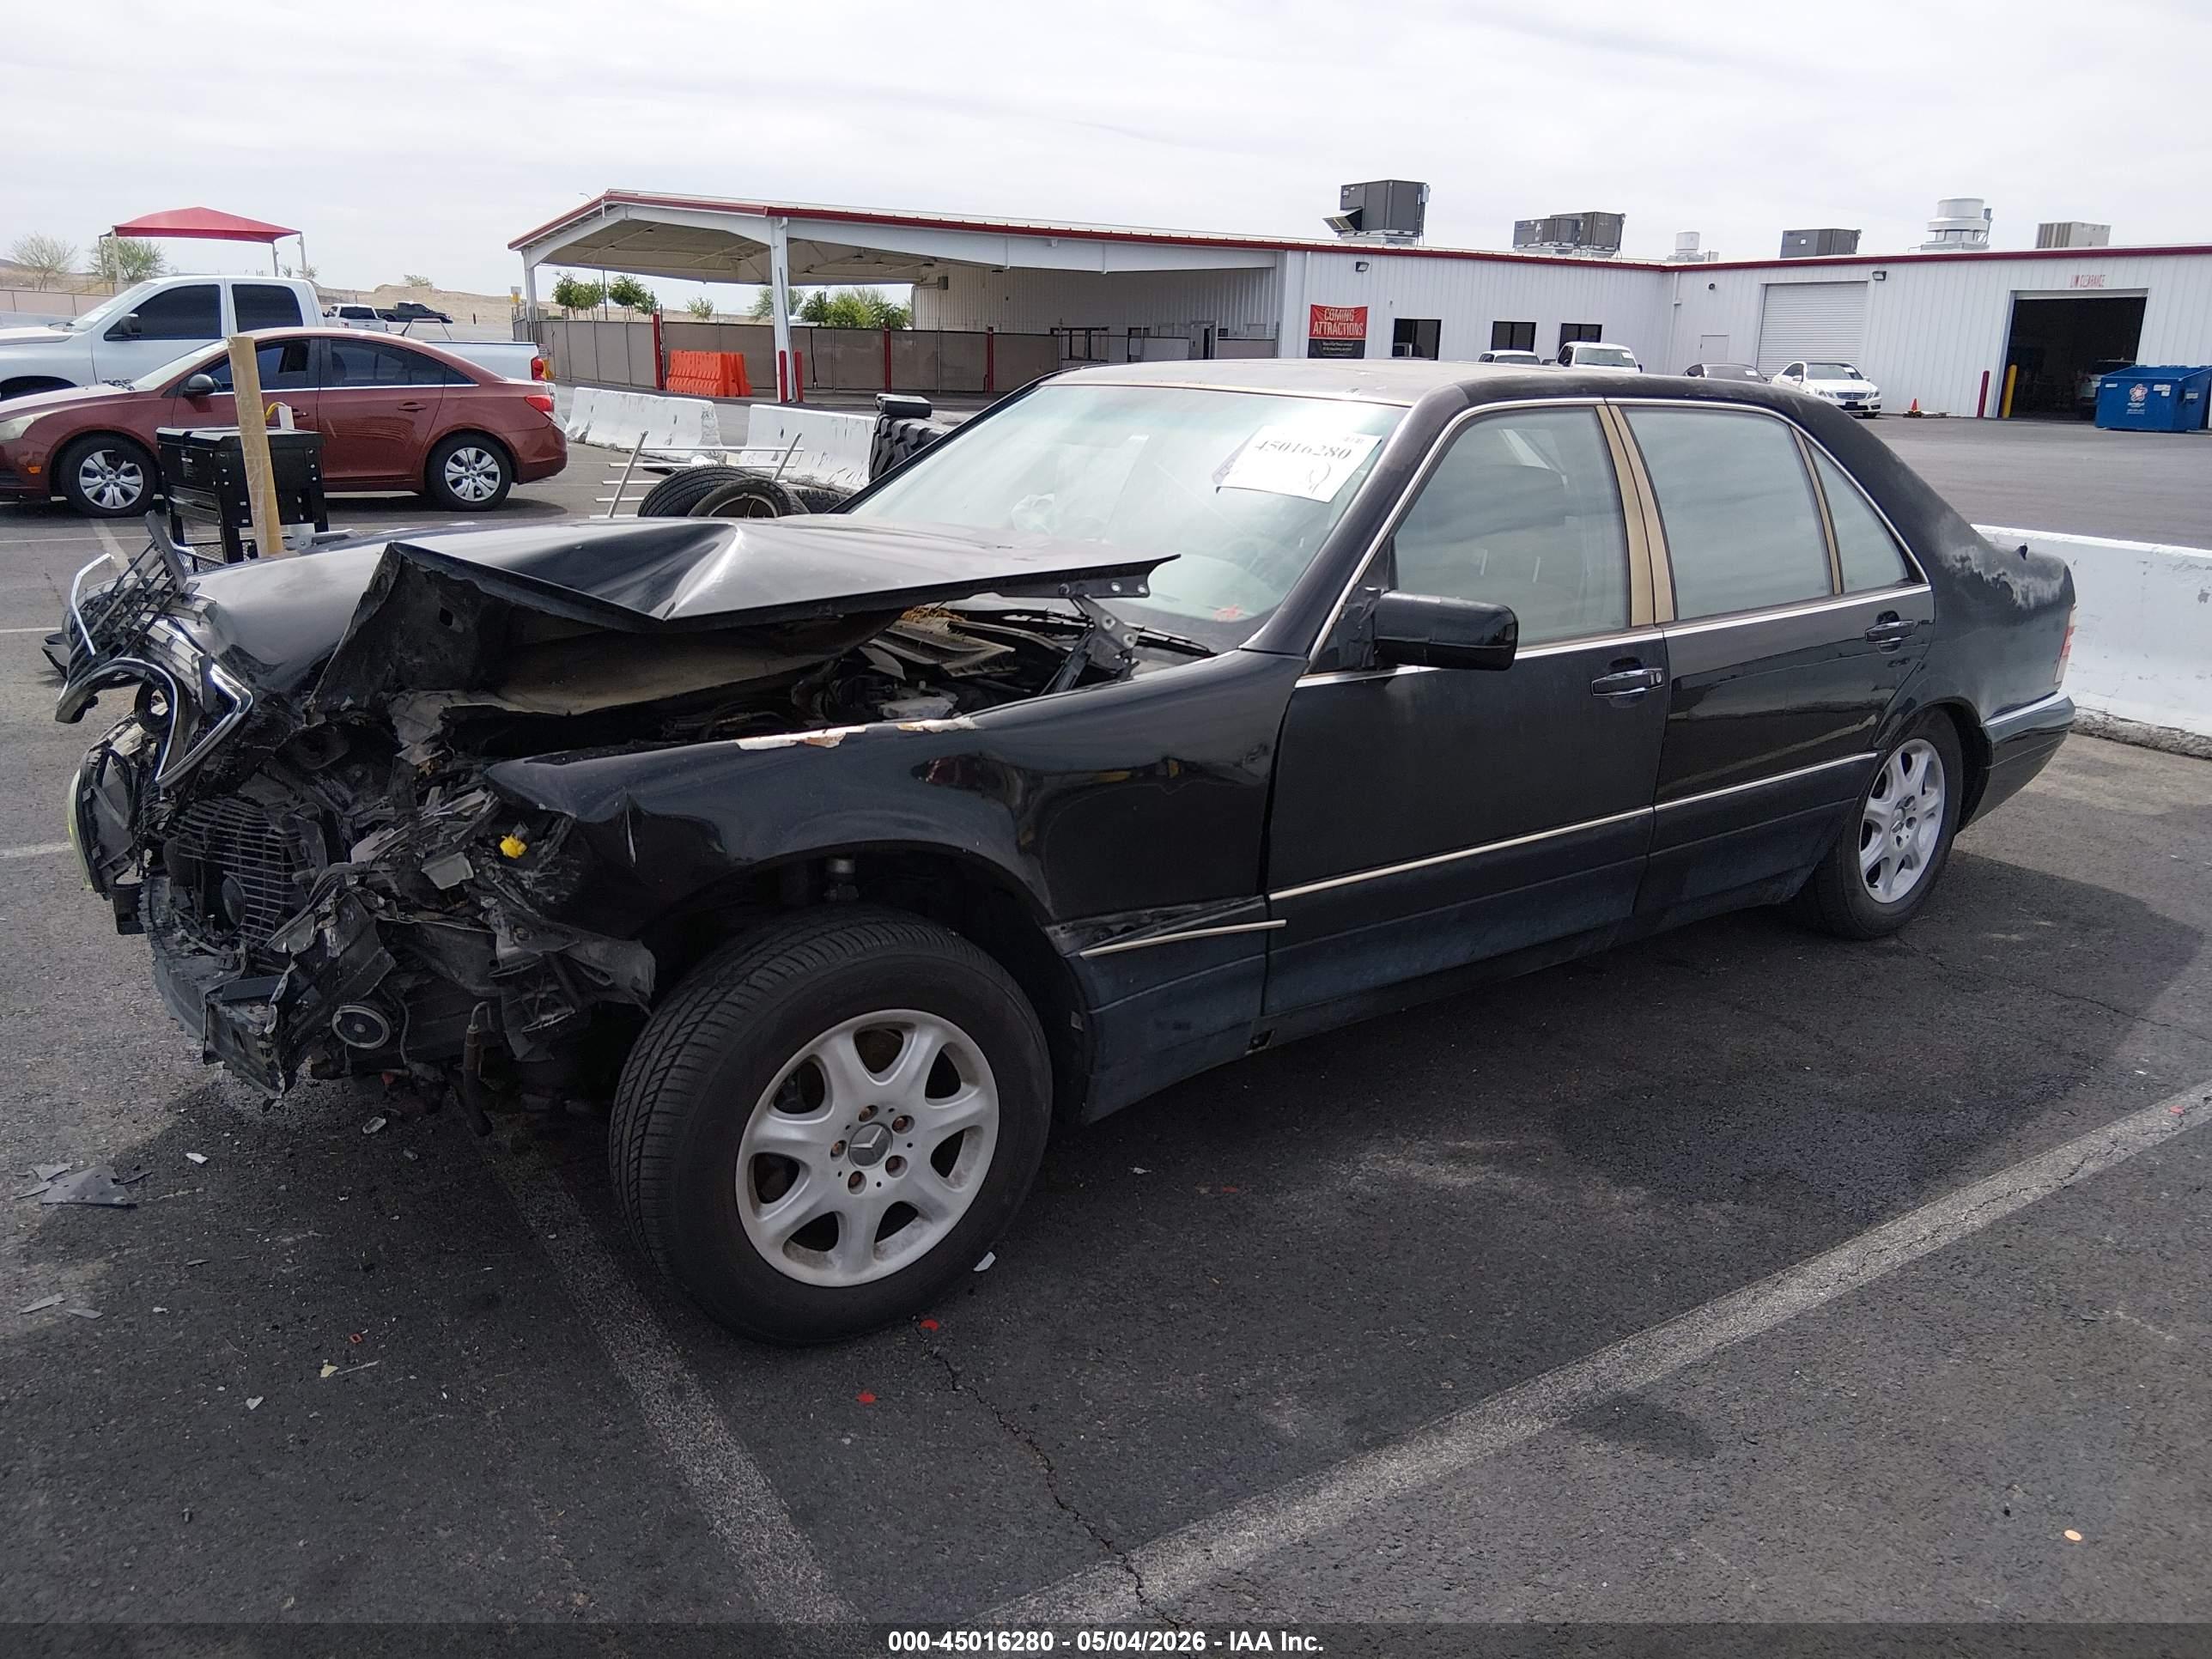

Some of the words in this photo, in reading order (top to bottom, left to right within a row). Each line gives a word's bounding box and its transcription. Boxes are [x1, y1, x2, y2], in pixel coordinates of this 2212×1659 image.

[1324, 307, 1355, 322] COMING
[1312, 321, 1364, 336] ATTRACTIONS
[1255, 440, 1352, 460] 45016280
